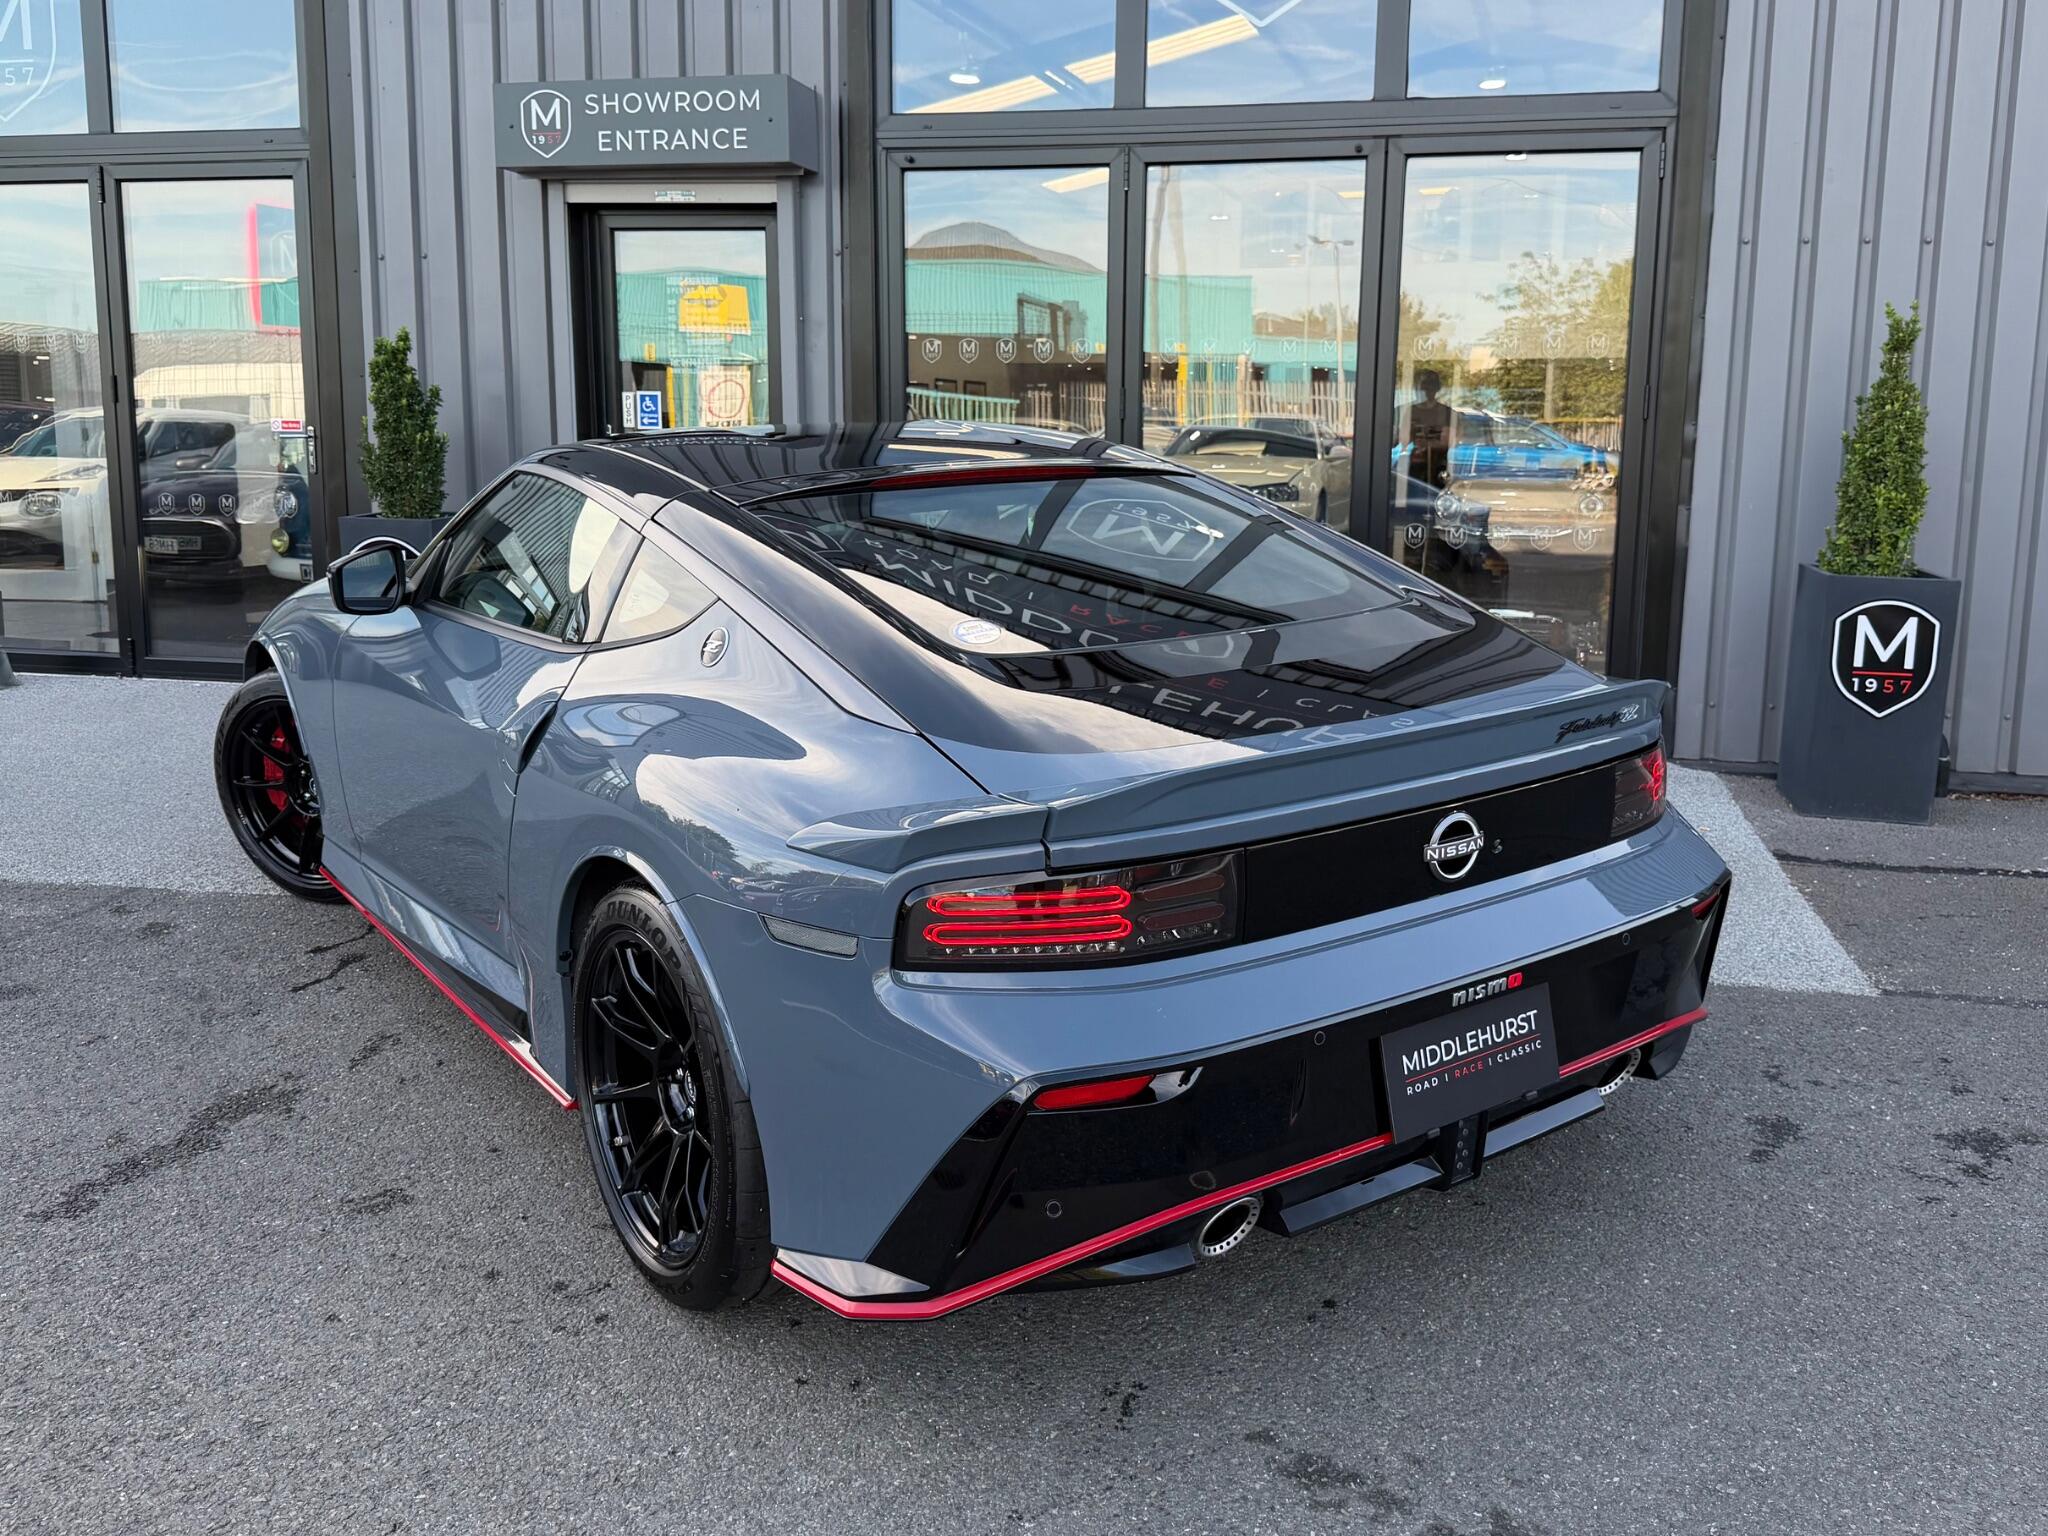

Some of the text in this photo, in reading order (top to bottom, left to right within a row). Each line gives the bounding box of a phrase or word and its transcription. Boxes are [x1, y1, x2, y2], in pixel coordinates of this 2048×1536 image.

[530, 98, 561, 130] M
[584, 89, 761, 115] SHOWROOM
[531, 135, 561, 145] 1957
[598, 127, 748, 152] ENTRANCE
[625, 395, 633, 425] PUSH
[1853, 614, 1918, 670] M
[1851, 677, 1912, 694] 1957
[1426, 835, 1484, 861] NISSAN
[606, 901, 681, 969] DUNLOP
[1402, 1009, 1538, 1075] MIDDLEHURST
[1407, 1077, 1439, 1096] ROAD
[1454, 1061, 1483, 1079] RACE
[1497, 1040, 1542, 1063] CLASSIC
